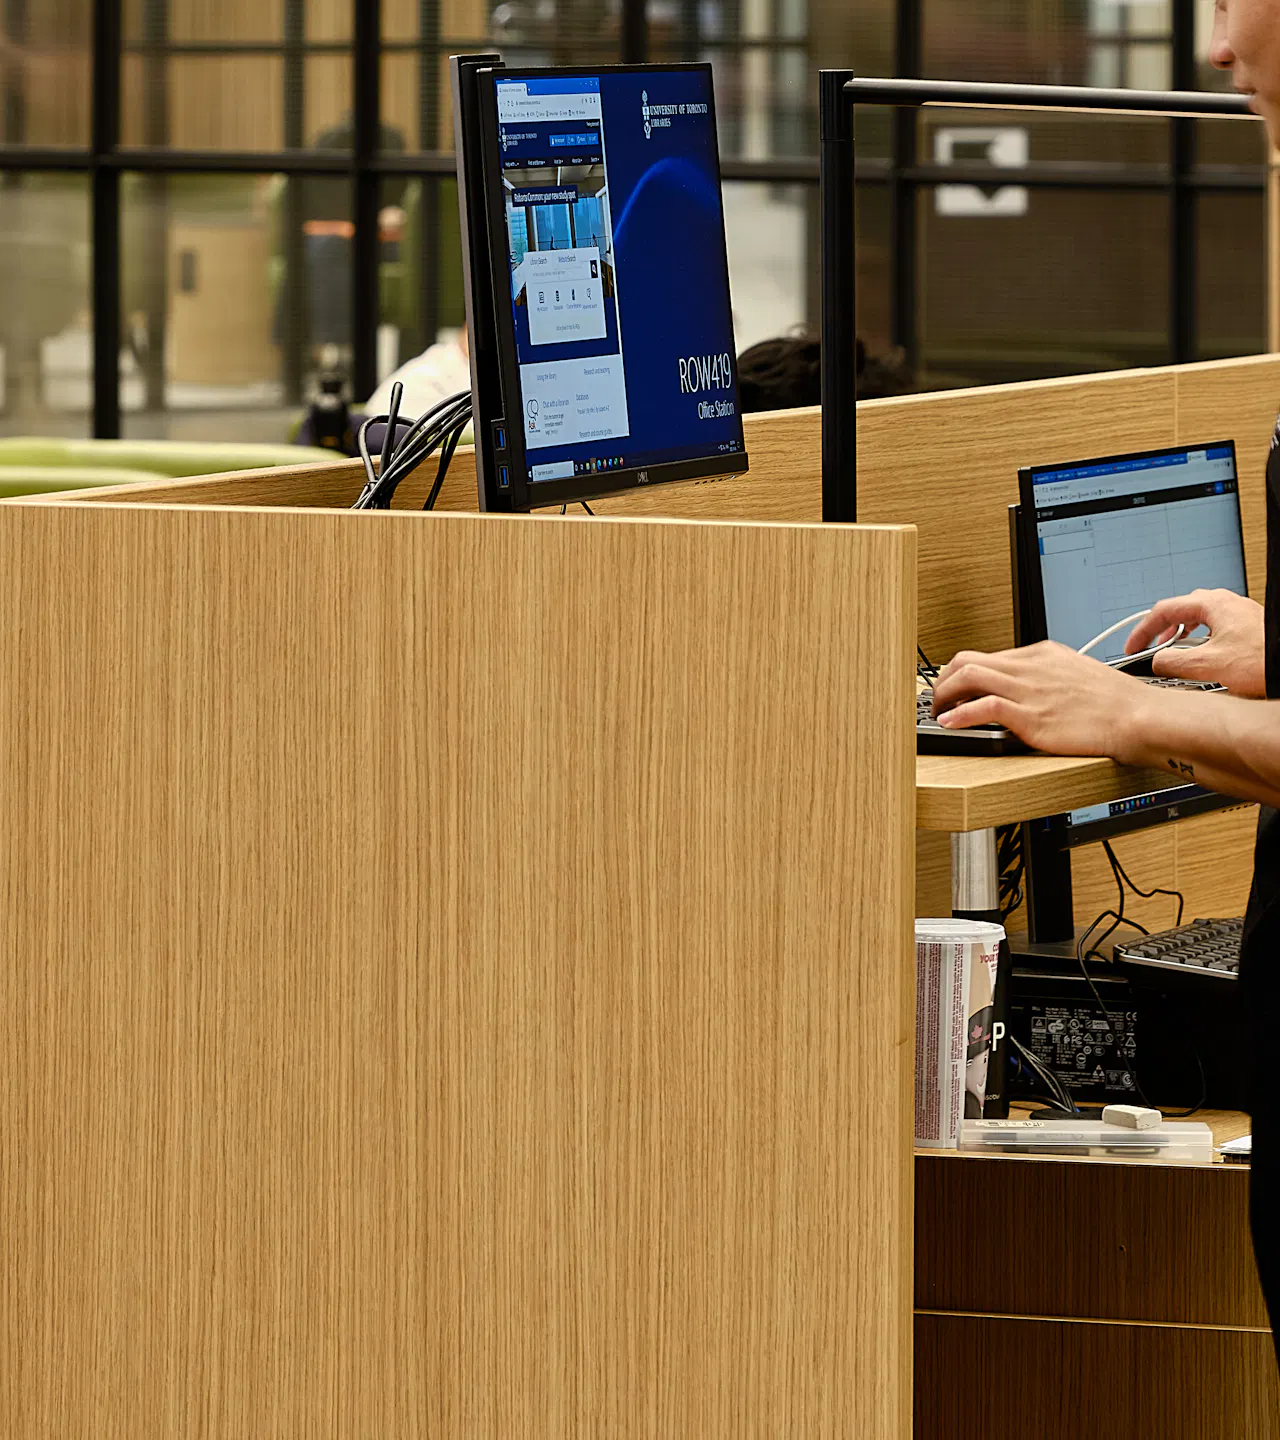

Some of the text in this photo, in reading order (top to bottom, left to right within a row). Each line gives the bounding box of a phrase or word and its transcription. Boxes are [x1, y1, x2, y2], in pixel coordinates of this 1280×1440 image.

[678, 104, 686, 115] OF
[686, 103, 708, 114] TORONTO
[679, 353, 732, 394] ROW419
[698, 400, 735, 420] Office Station
